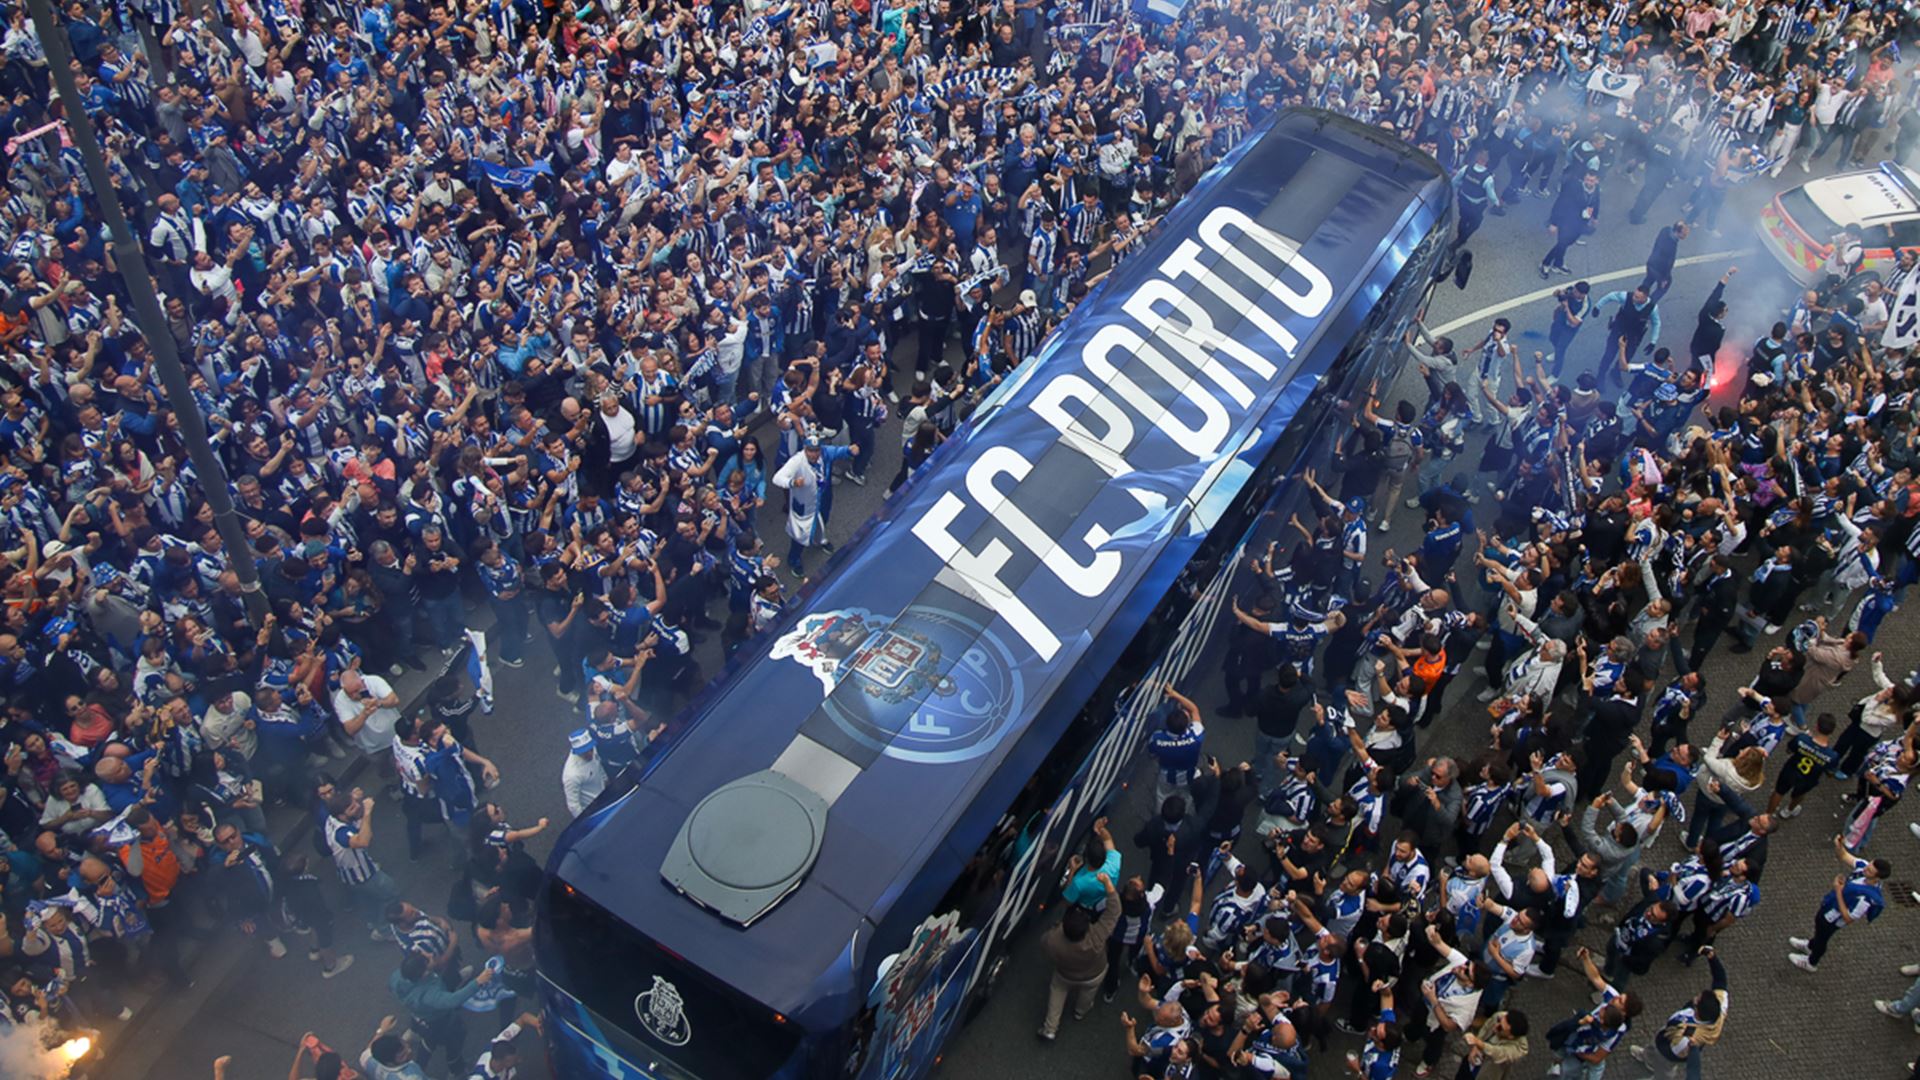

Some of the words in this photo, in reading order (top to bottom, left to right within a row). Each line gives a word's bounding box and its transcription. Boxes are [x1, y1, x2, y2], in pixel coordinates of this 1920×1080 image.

[911, 446, 1122, 663] FC
[1028, 206, 1334, 519] PORTO
[1797, 757, 1814, 775] 8
